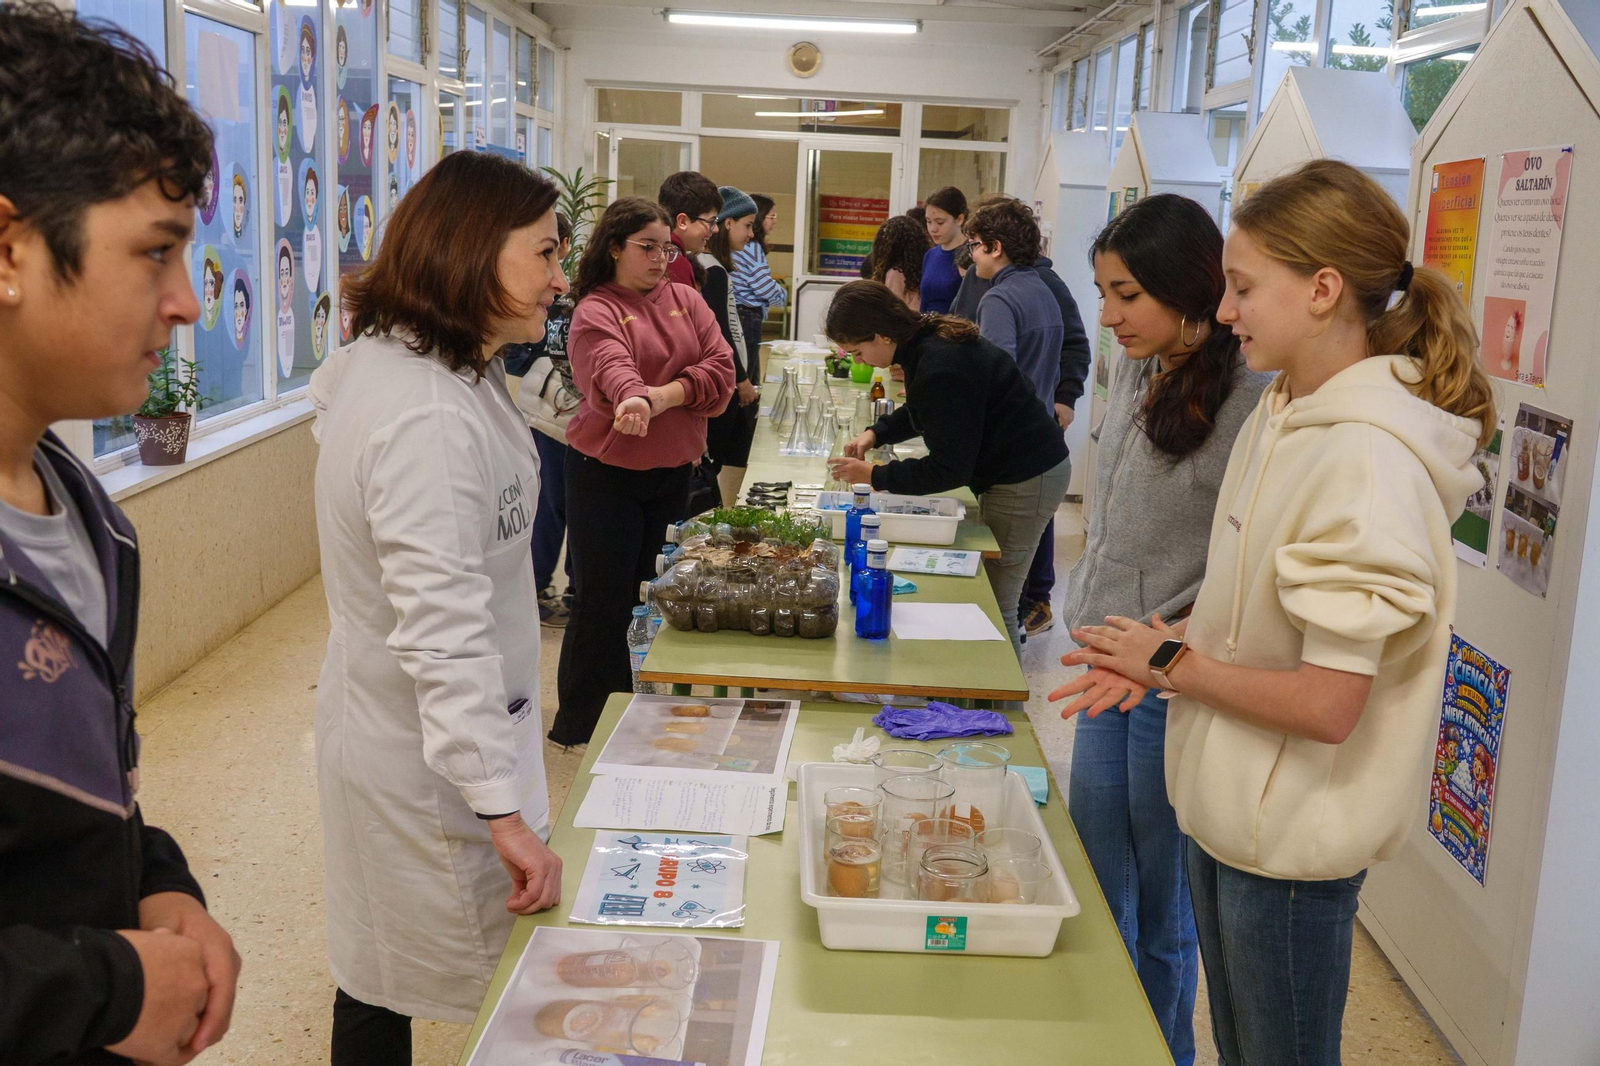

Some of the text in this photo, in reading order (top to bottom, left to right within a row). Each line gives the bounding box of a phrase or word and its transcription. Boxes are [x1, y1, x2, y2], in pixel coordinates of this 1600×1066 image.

[1524, 156, 1542, 171] OVO
[1516, 175, 1553, 191] SALTARÍN
[1434, 194, 1476, 210] uperficial
[498, 502, 530, 541] MOL
[1462, 646, 1492, 679] DÍA DE LA
[1455, 659, 1497, 708] CIENCIA
[1445, 704, 1464, 723] NIEVE
[656, 854, 680, 886] GRUPO
[653, 890, 674, 899] 8
[573, 1052, 608, 1064] Lacer
